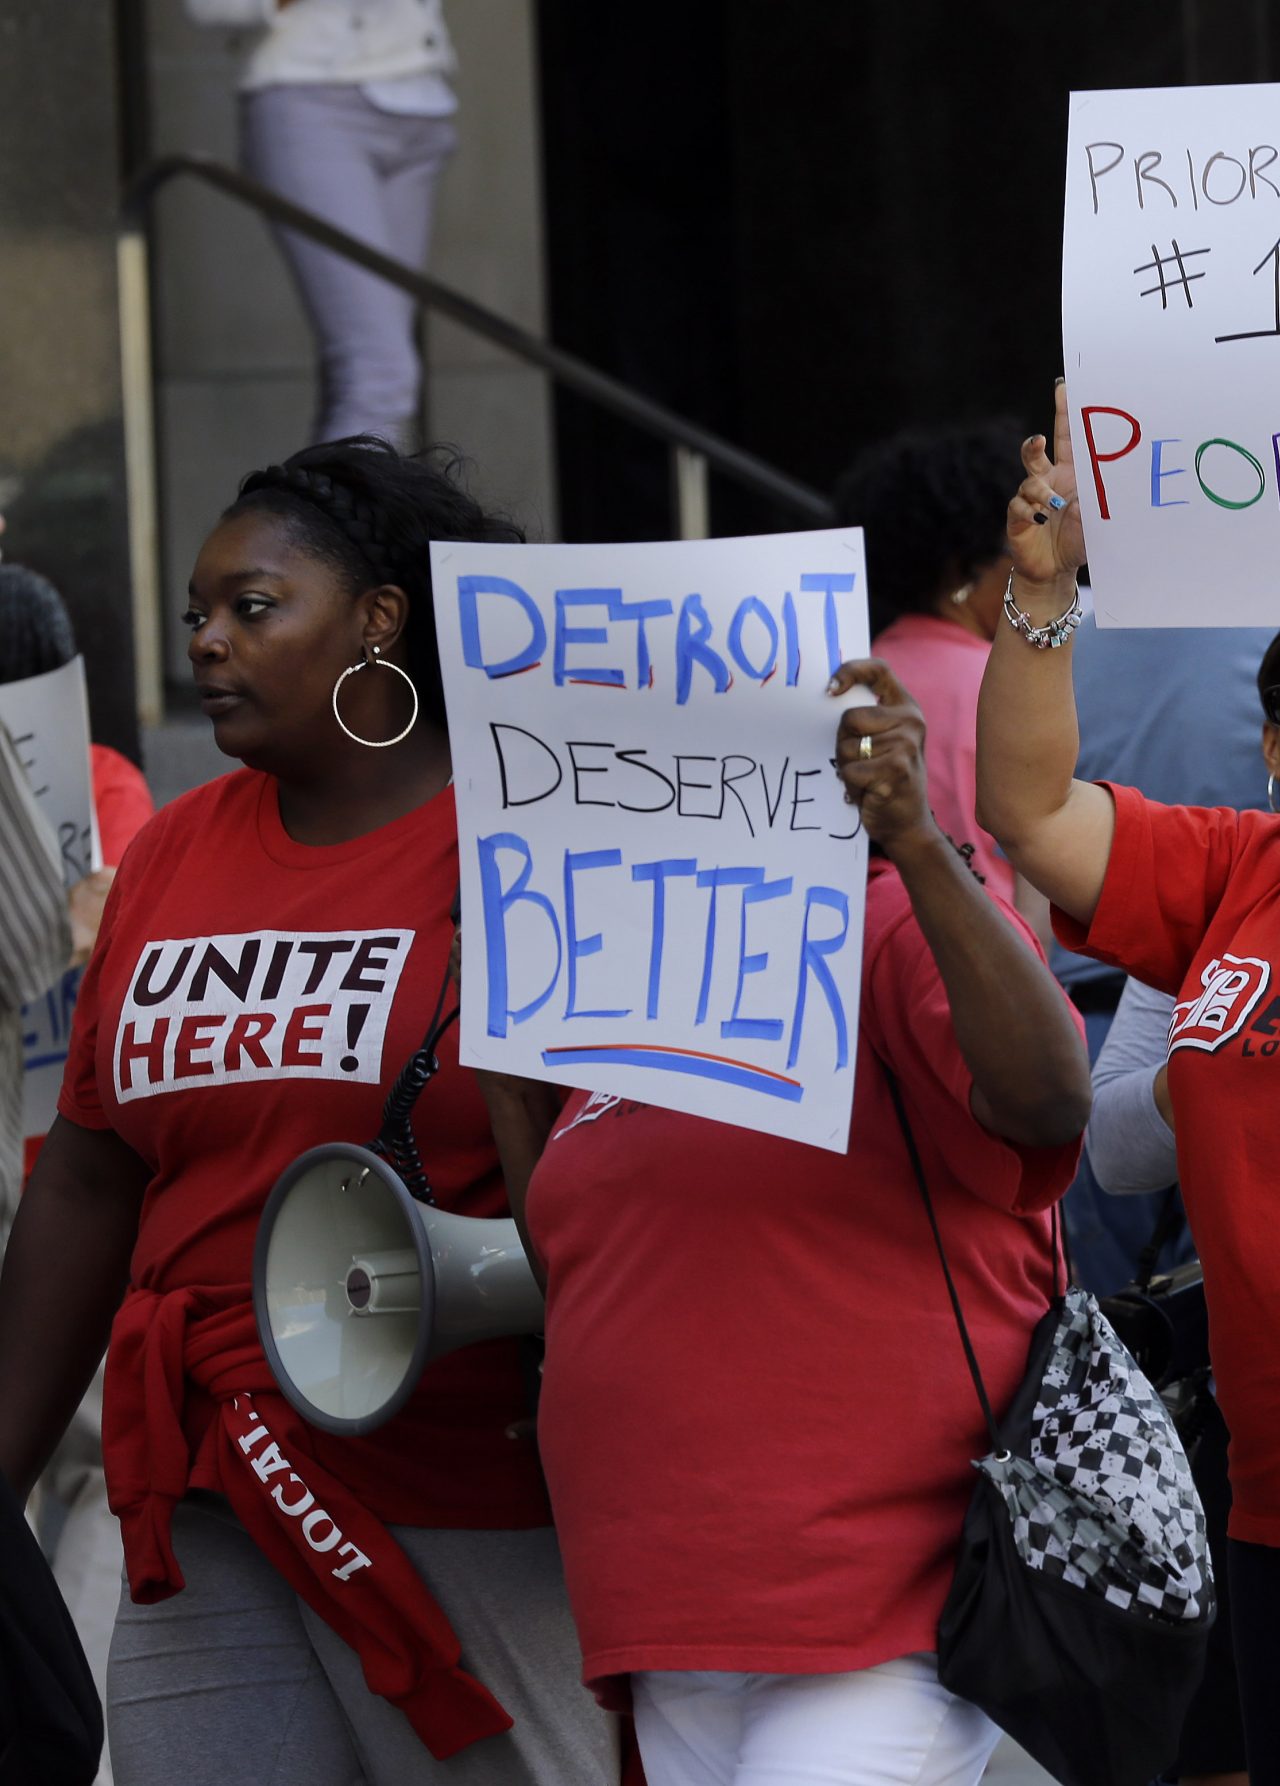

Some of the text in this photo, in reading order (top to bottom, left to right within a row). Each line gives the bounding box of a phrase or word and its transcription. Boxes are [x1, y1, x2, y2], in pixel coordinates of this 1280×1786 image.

[457, 572, 857, 705] DETROIT
[133, 936, 401, 1006] UNITE
[476, 832, 851, 1075] BETTER
[119, 1003, 372, 1093] HERE!
